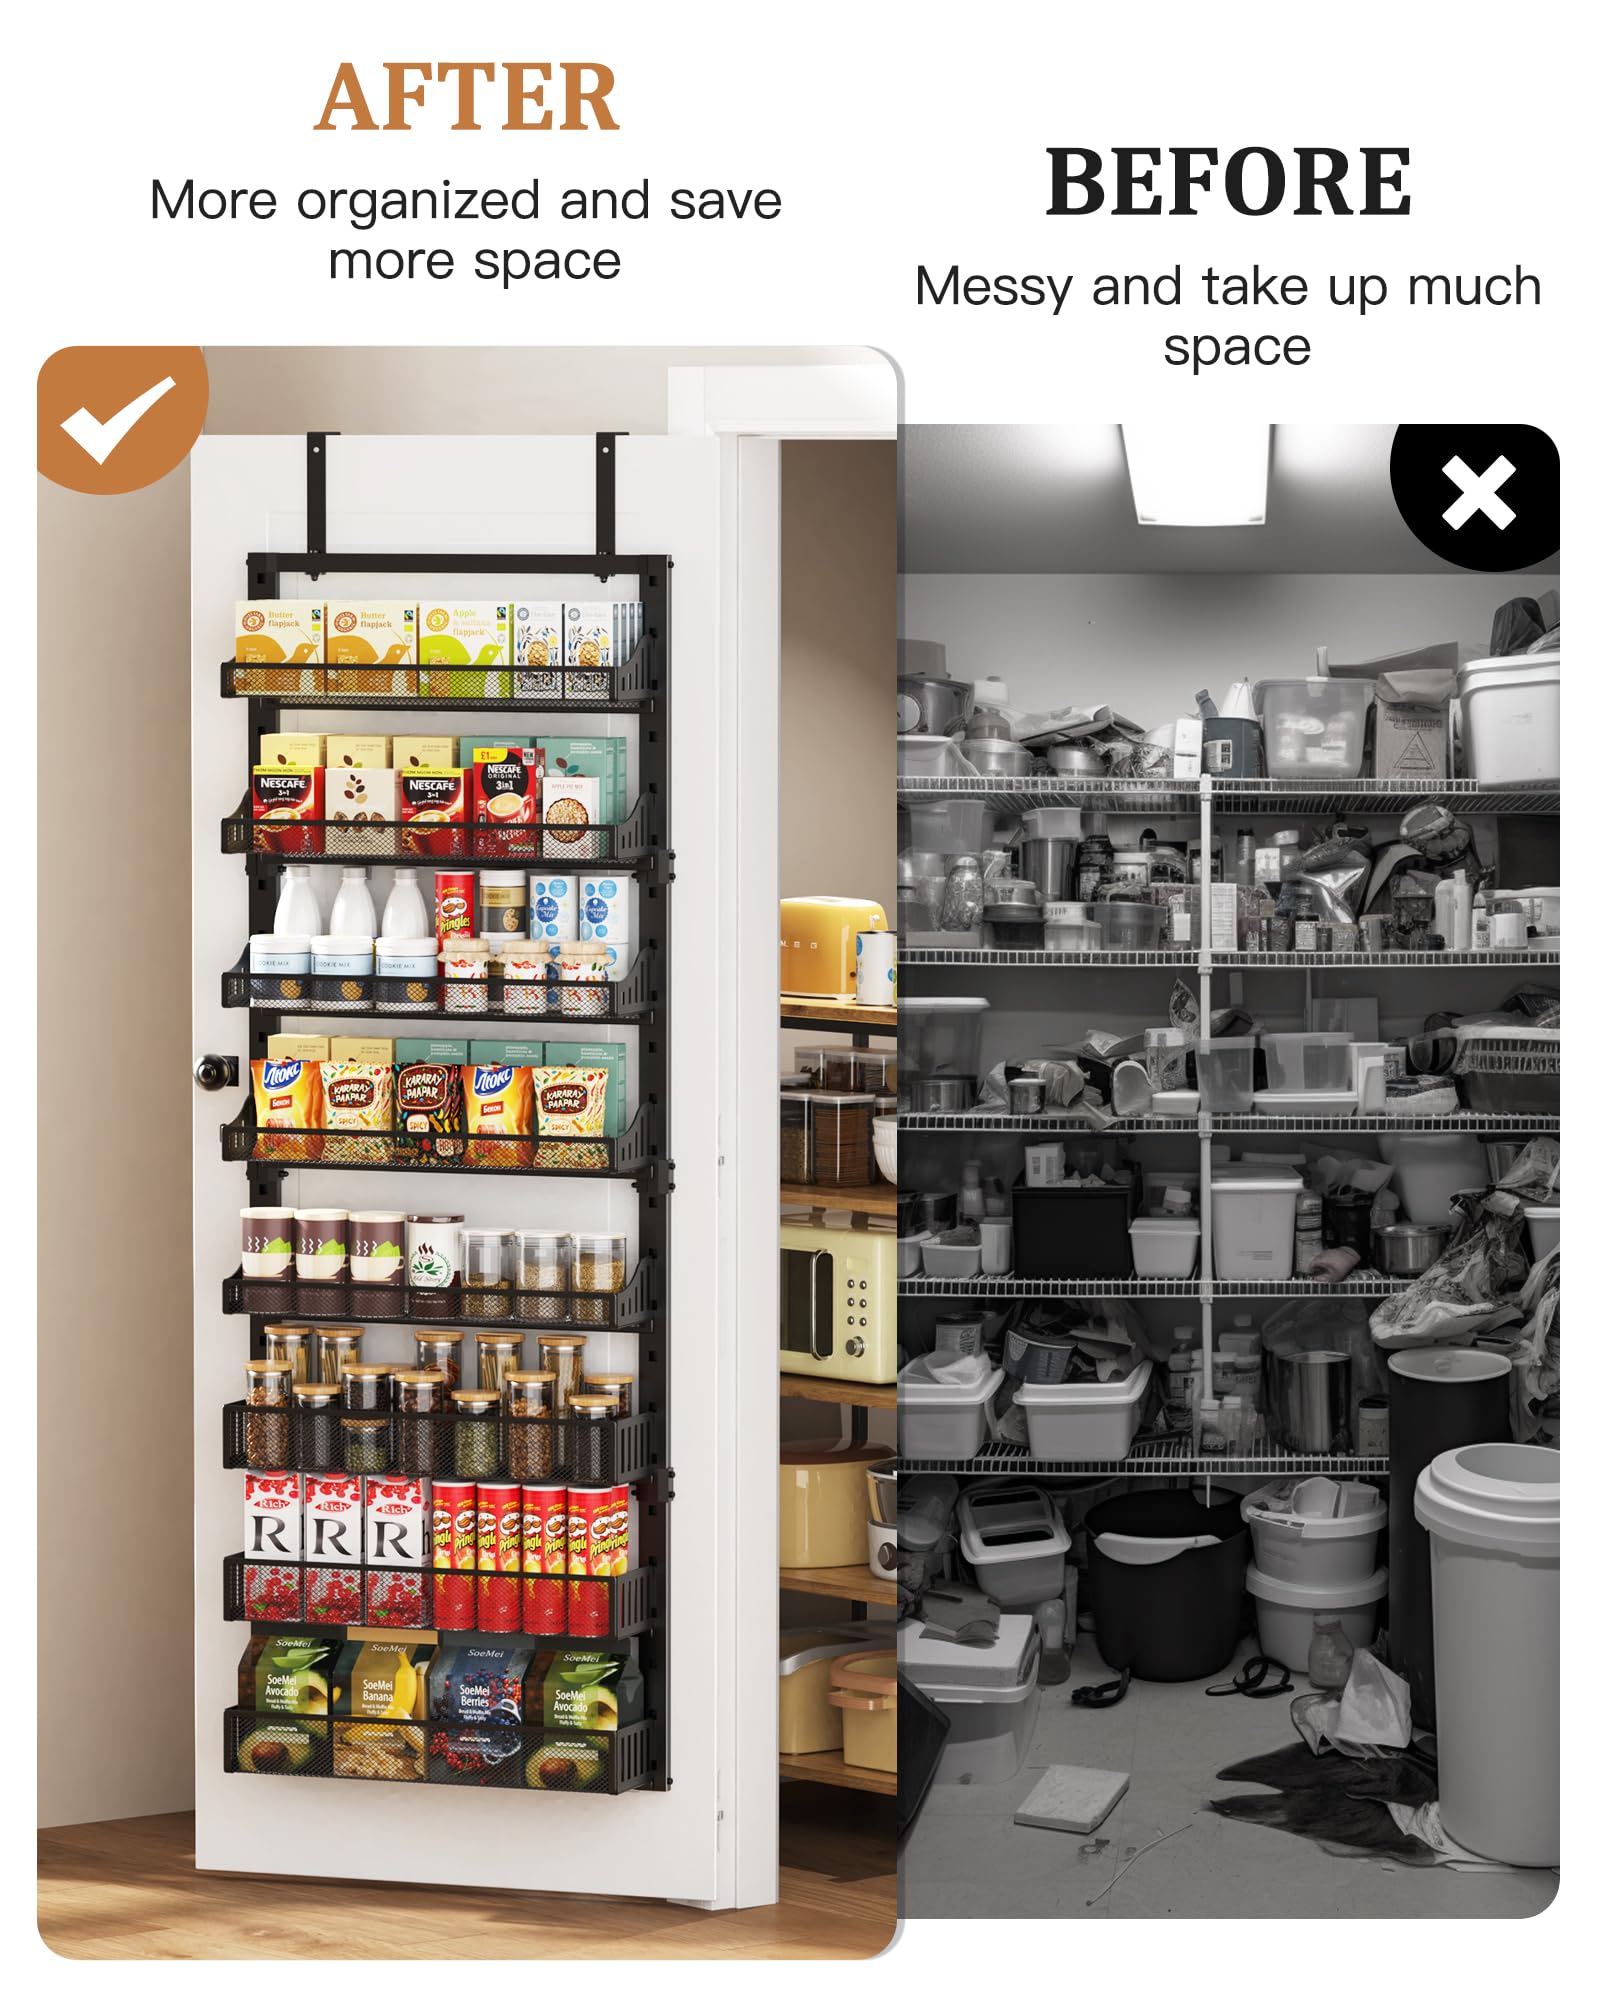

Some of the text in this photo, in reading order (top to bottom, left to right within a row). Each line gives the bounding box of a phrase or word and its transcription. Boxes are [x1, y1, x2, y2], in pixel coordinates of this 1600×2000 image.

[268, 611, 293, 619] Butter
[268, 620, 300, 628] flapjack
[360, 621, 392, 629] flapjack
[259, 1498, 286, 1509] Rich
[320, 1501, 348, 1512] Rich
[381, 1504, 409, 1515] Rich
[252, 1515, 292, 1554] R
[313, 1518, 353, 1556] R
[374, 1521, 414, 1559] R
[275, 1639, 311, 1648] SoeMei
[371, 1643, 407, 1653] SoeMei
[467, 1648, 504, 1658] SoeMei
[563, 1653, 599, 1663] SoeMei
[267, 1674, 297, 1685] SoeMei
[363, 1679, 393, 1691] SoeMei
[265, 1685, 299, 1697] Avocado
[460, 1685, 490, 1696] SoeMei
[555, 1690, 586, 1701] SoeMei
[363, 1691, 393, 1702] Banana
[461, 1695, 489, 1707] Berries
[553, 1700, 588, 1712] Avocado
